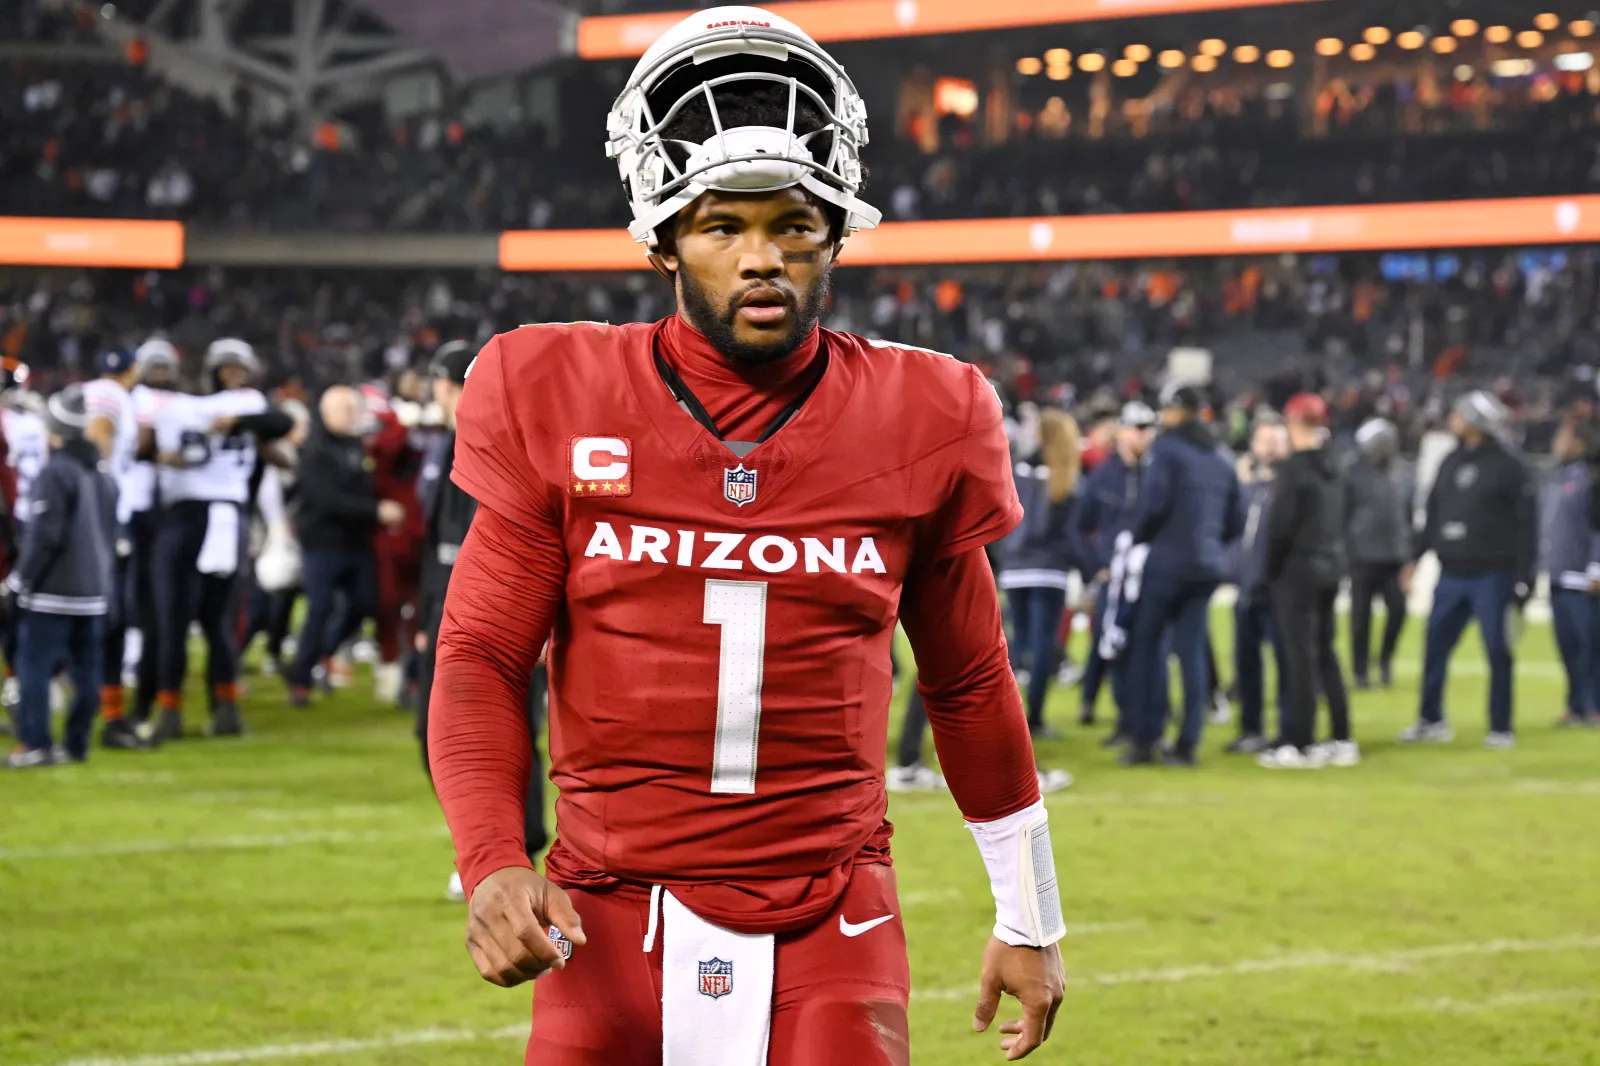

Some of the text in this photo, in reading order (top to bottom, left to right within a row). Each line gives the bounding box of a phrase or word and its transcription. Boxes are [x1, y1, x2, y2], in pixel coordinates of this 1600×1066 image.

[706, 20, 770, 29] CARDINALS
[572, 437, 629, 480] C
[729, 483, 752, 499] NFL
[584, 521, 887, 574] ARIZONA
[703, 578, 768, 794] 1
[702, 975, 730, 995] NFL
